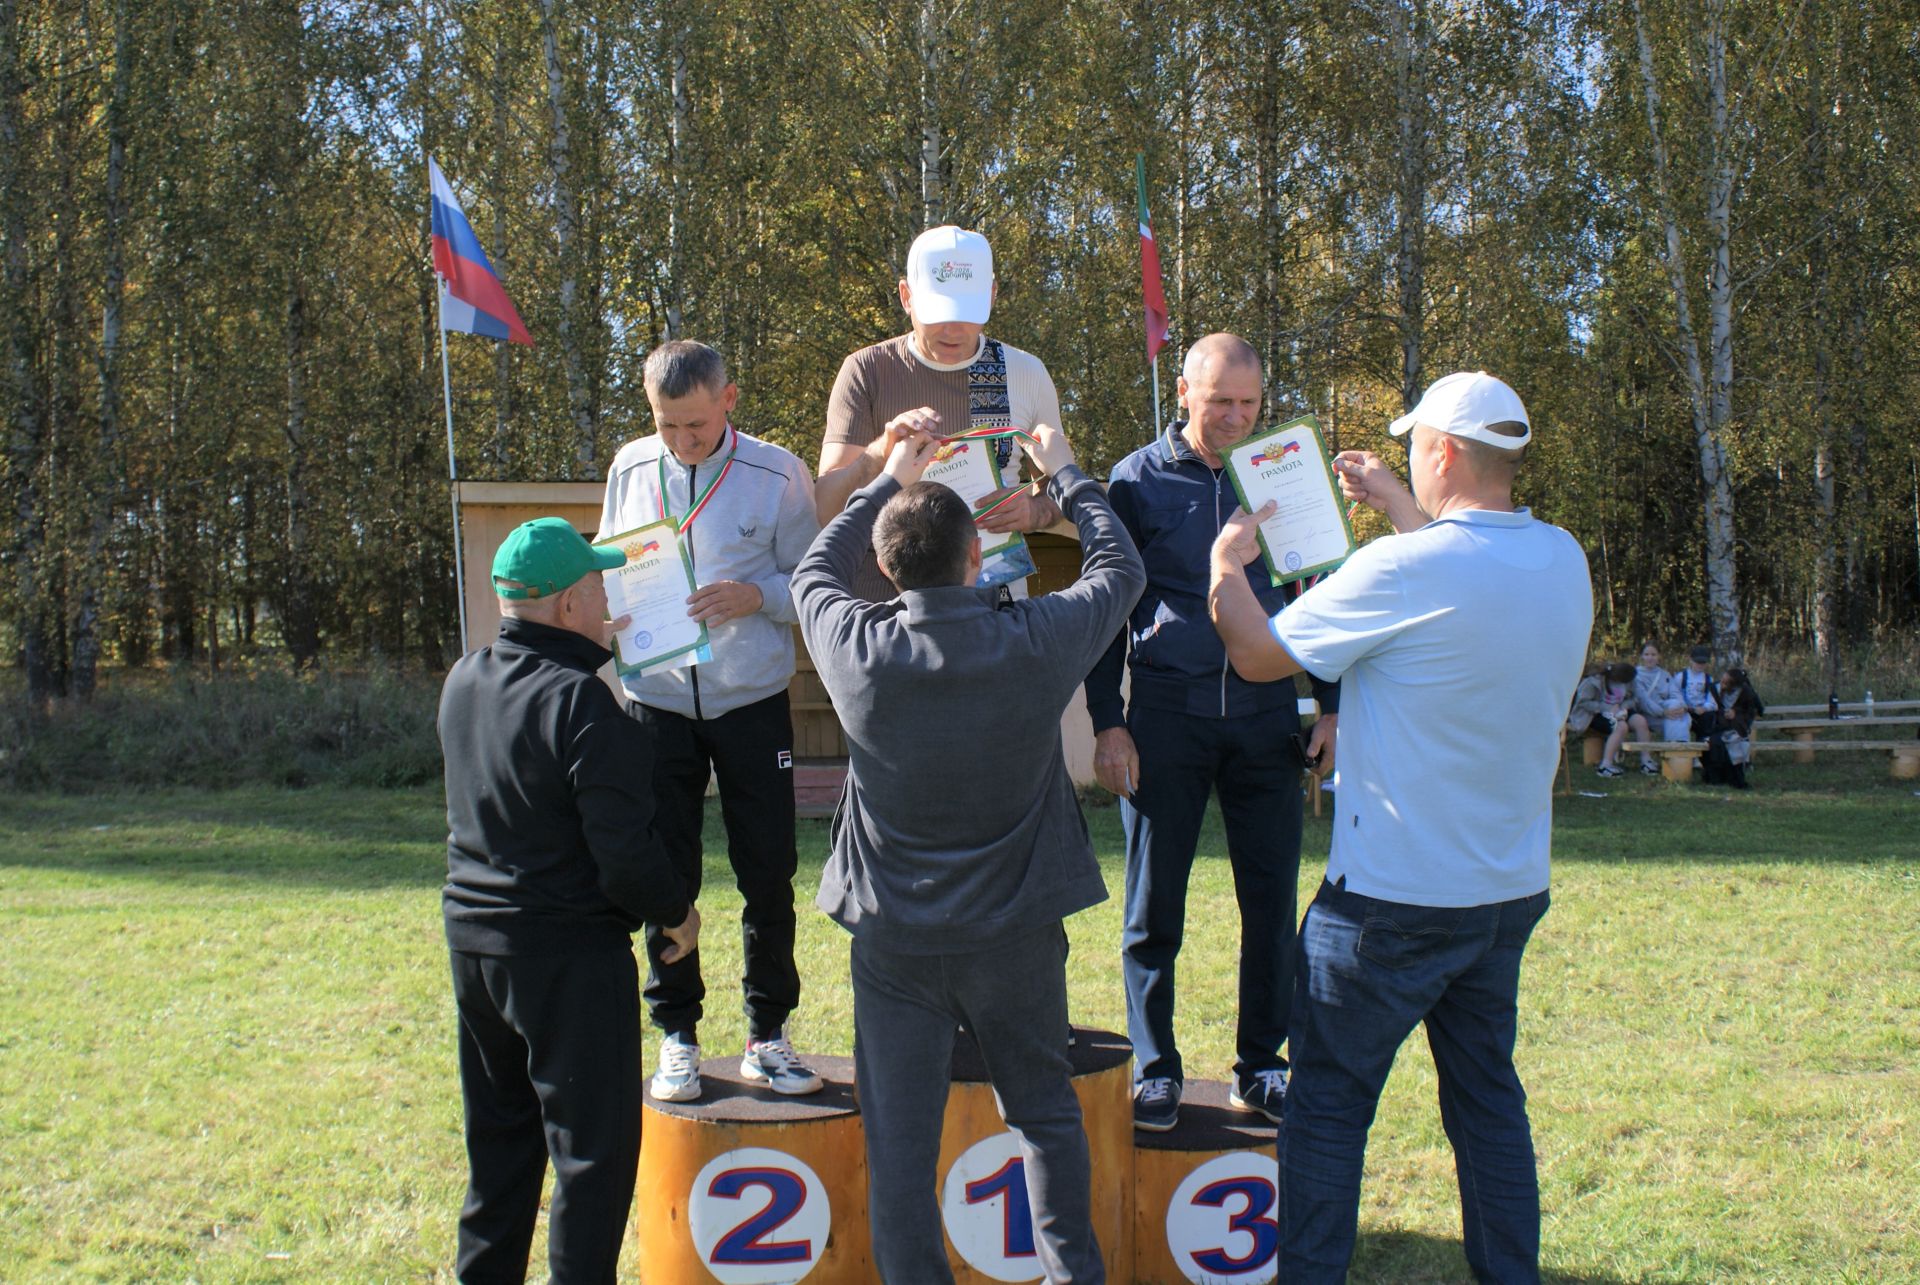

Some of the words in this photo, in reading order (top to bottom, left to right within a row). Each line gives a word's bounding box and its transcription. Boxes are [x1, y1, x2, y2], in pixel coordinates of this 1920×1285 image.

[928, 459, 968, 478] ГРАМОТА
[1261, 460, 1303, 479] ГРАМОТА
[618, 558, 660, 576] ГРАМОТА
[708, 1167, 812, 1264] 2
[965, 1156, 1037, 1258] 1
[1190, 1175, 1279, 1275] 3
